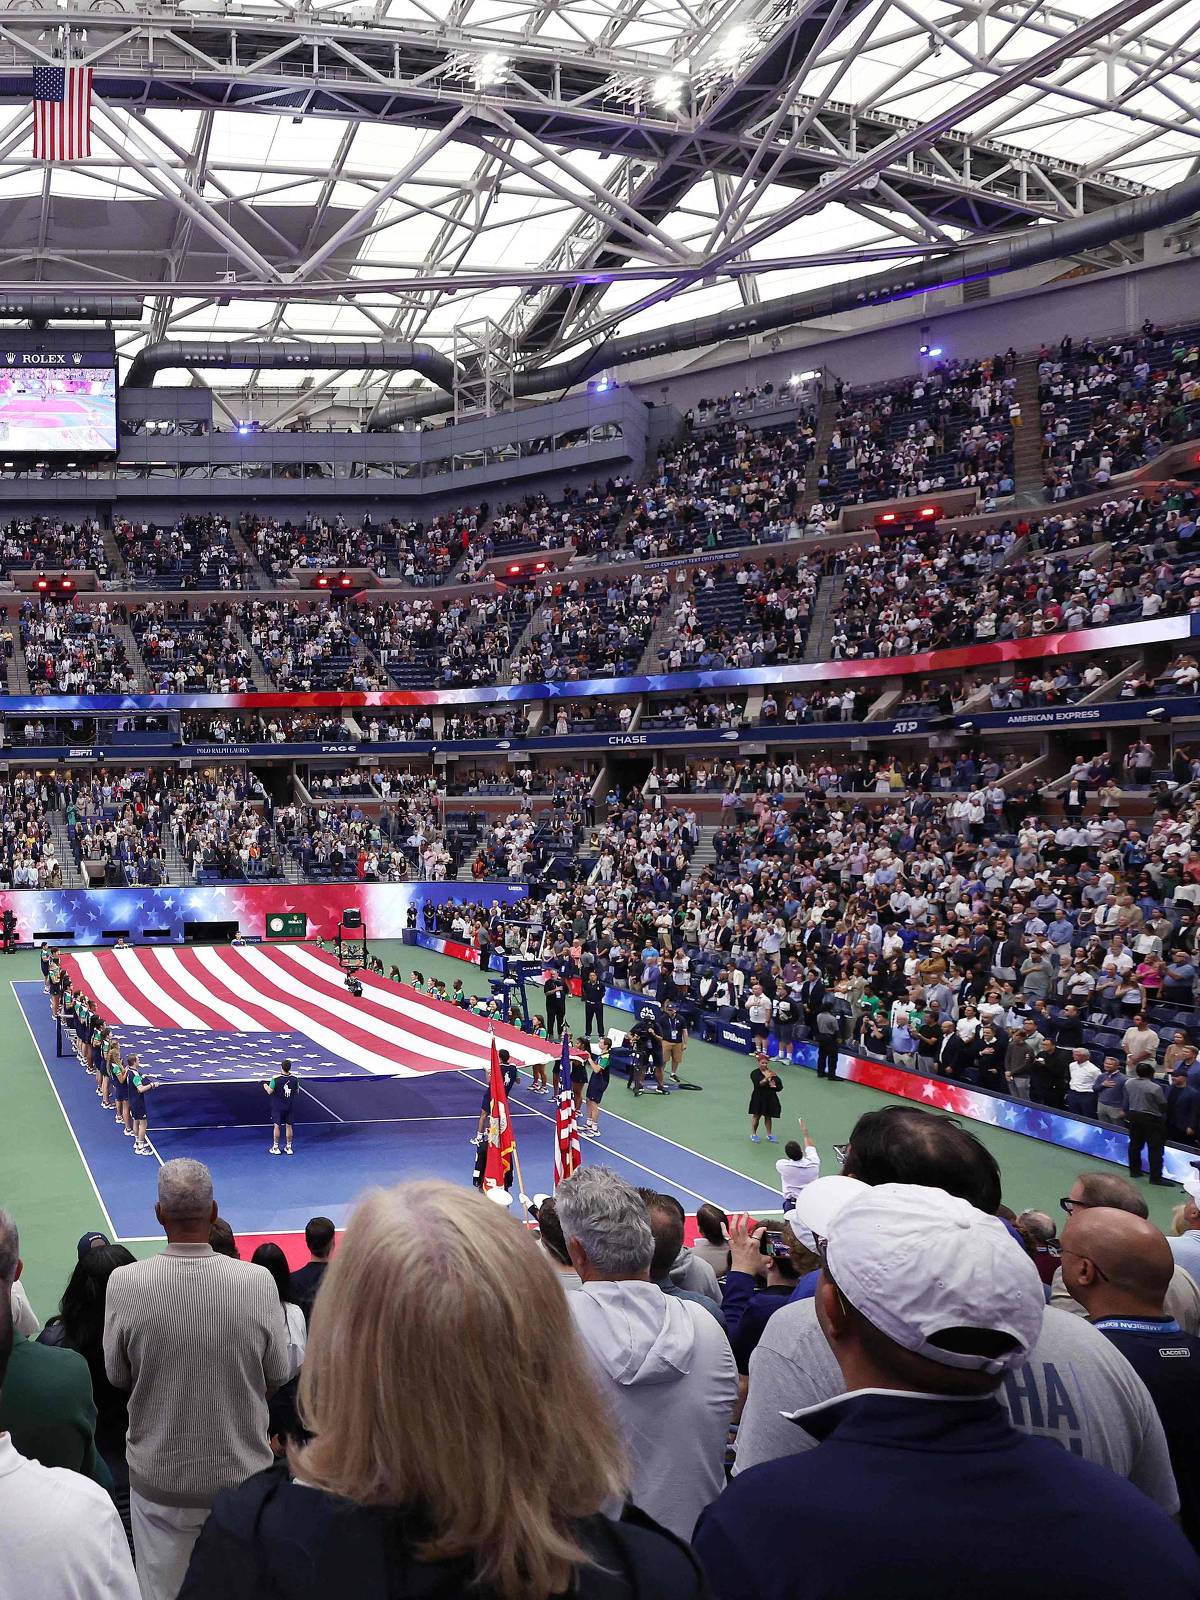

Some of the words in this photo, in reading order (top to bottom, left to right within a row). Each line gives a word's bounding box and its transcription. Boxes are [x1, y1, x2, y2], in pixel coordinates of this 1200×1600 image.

[22, 354, 67, 364] ROLEX
[1007, 712, 1054, 724] AMERICAN
[1055, 710, 1101, 721] EXPRESS
[892, 721, 918, 733] ATP
[608, 735, 648, 745] CHASE
[69, 749, 93, 757] ESPN
[723, 1030, 747, 1046] Wilson
[1120, 1322, 1163, 1331] AMERICAN
